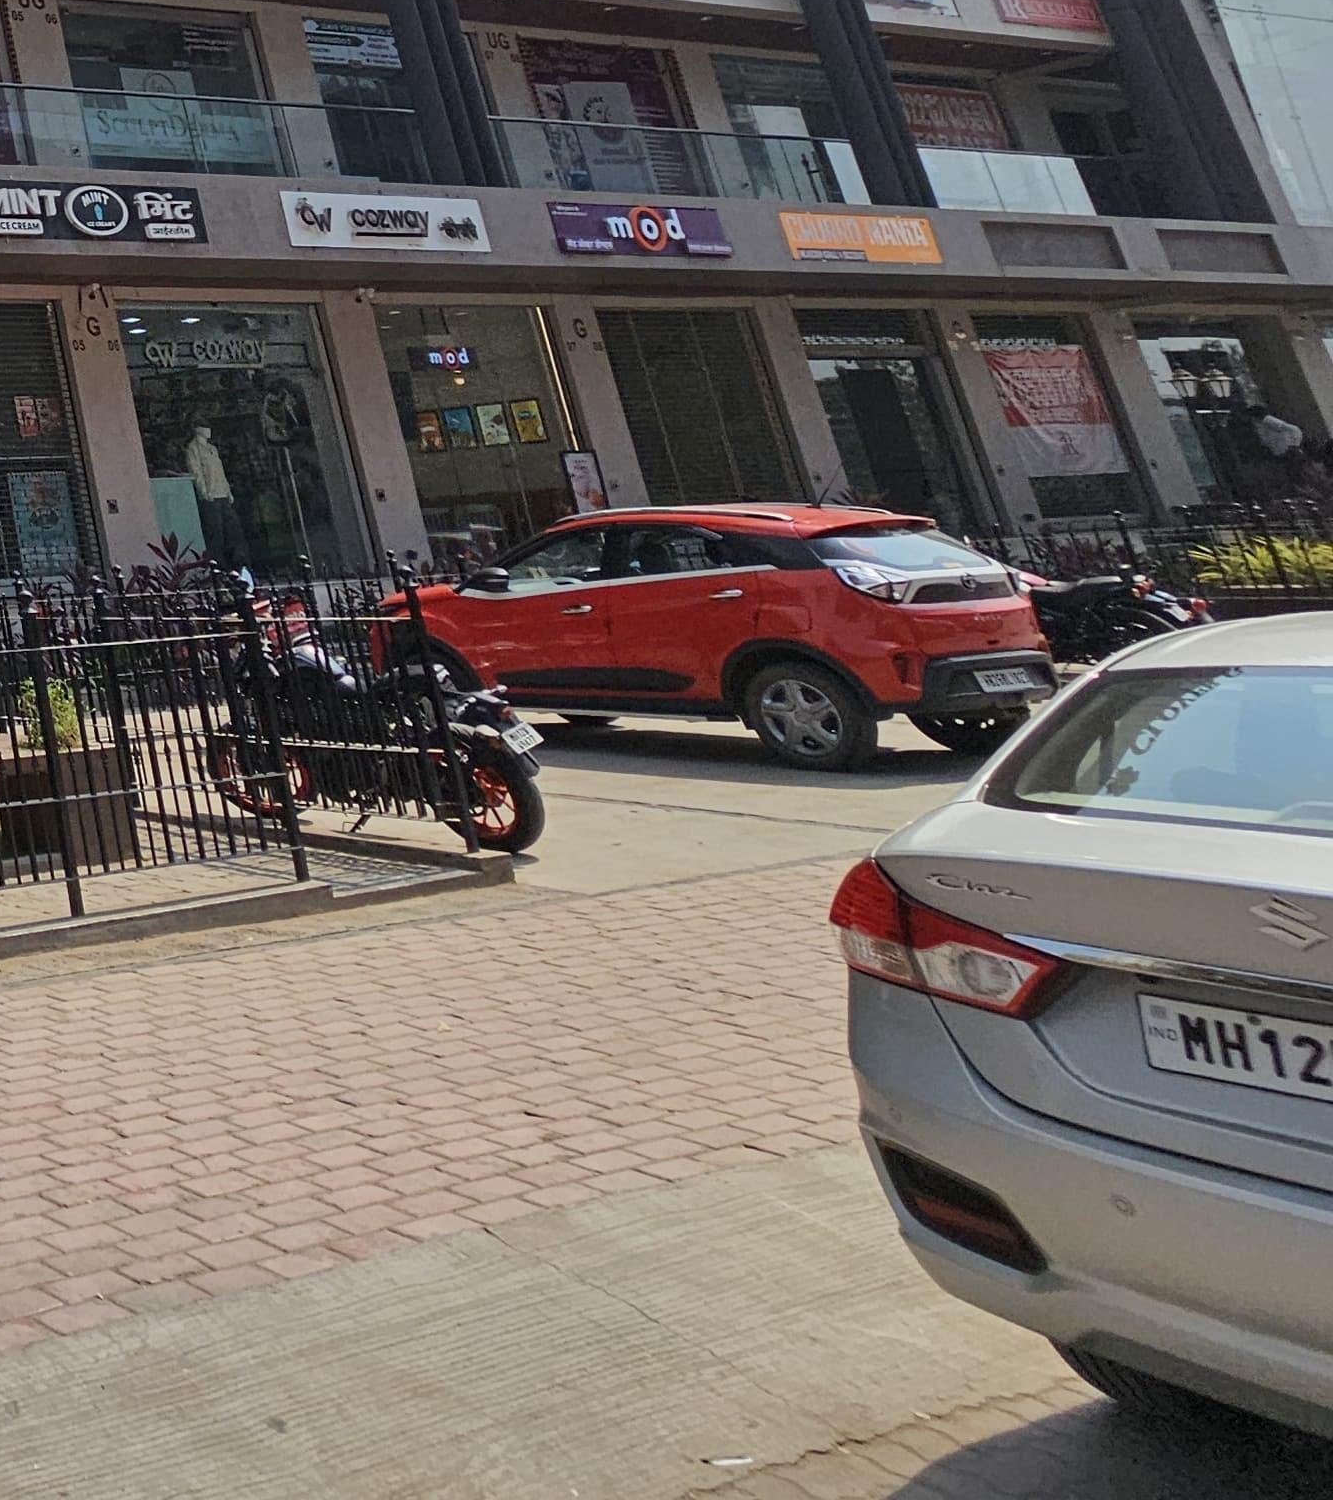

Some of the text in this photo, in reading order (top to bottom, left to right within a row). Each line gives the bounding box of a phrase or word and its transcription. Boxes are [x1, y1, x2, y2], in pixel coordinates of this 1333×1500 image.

[11, 10, 58, 25] 05 06
[485, 32, 510, 50] UG
[80, 190, 110, 208] MINT
[133, 191, 194, 222] मिंट
[11, 220, 41, 232] CREAM
[604, 207, 686, 242] mod
[86, 316, 102, 337] G
[572, 318, 589, 339] G
[72, 339, 86, 352] 05
[428, 347, 470, 365] mod
[1148, 1023, 1179, 1042] IND
